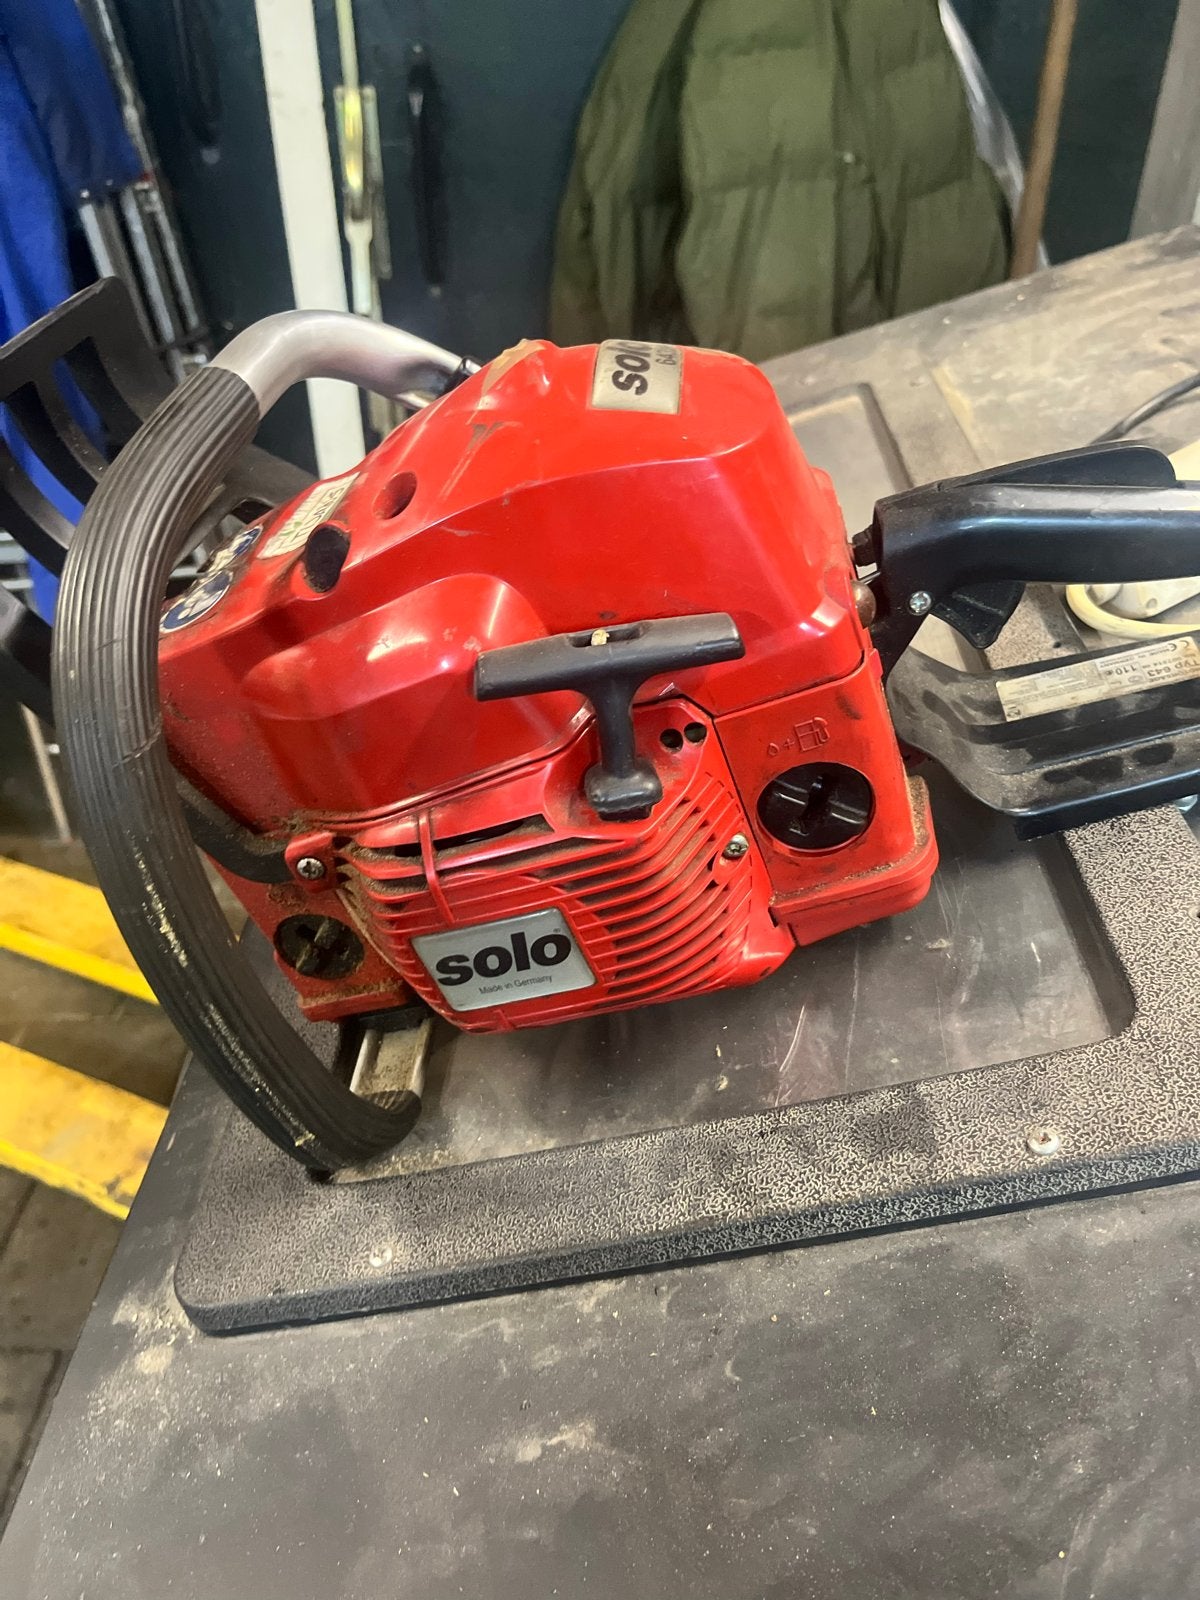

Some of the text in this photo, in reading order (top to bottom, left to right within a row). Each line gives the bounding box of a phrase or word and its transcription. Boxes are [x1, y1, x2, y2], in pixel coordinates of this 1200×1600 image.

[1115, 664, 1137, 675] 110
[1147, 666, 1171, 677] 643
[436, 931, 572, 986] solo
[479, 976, 553, 994] Made in Germany
